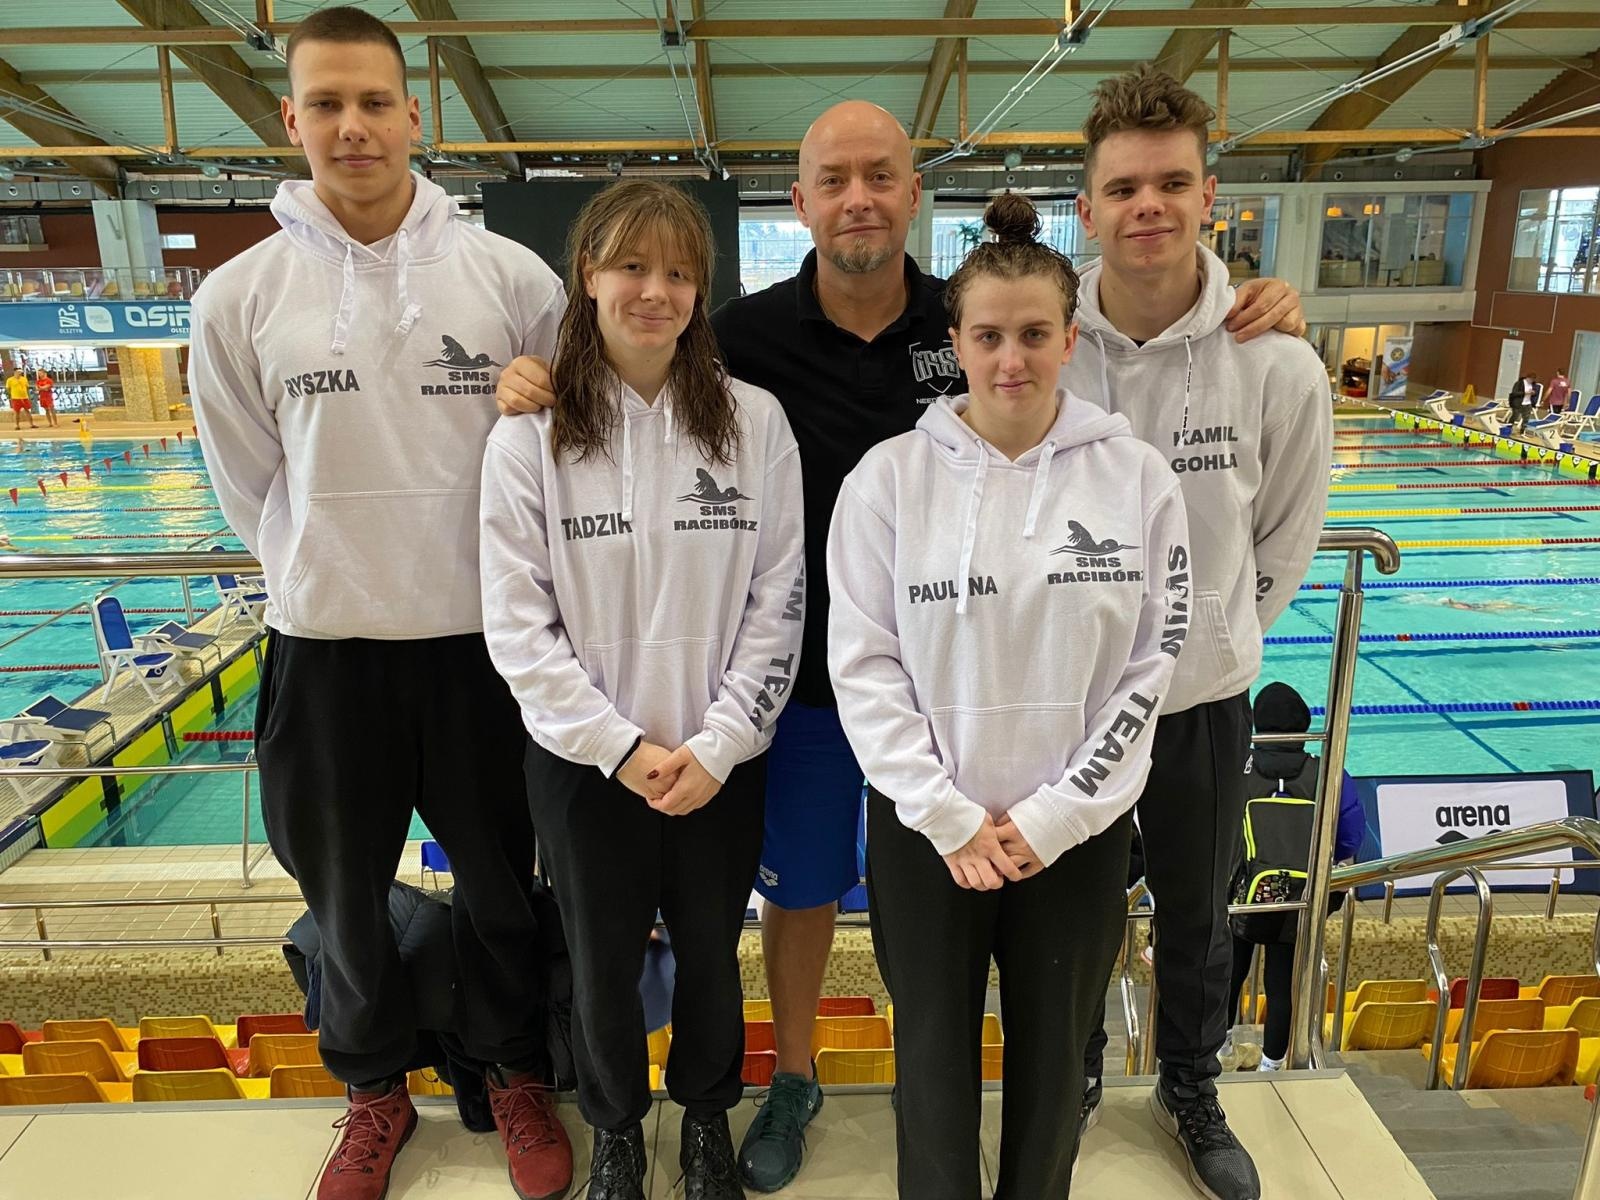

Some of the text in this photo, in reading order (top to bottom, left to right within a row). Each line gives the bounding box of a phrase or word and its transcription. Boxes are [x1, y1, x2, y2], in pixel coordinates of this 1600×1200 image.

[284, 369, 360, 398] RYSZKA
[448, 371, 490, 382] SMS
[1173, 426, 1239, 447] KAMIL
[1170, 453, 1238, 473] GOHLA
[700, 505, 737, 516] SMS
[561, 512, 633, 540] TADZIK
[674, 517, 758, 532] RACIBÓRZ
[1076, 556, 1121, 568] SMS
[908, 575, 998, 604] PAULNA
[1069, 691, 1159, 798] TEAM
[1435, 804, 1511, 827] arena
